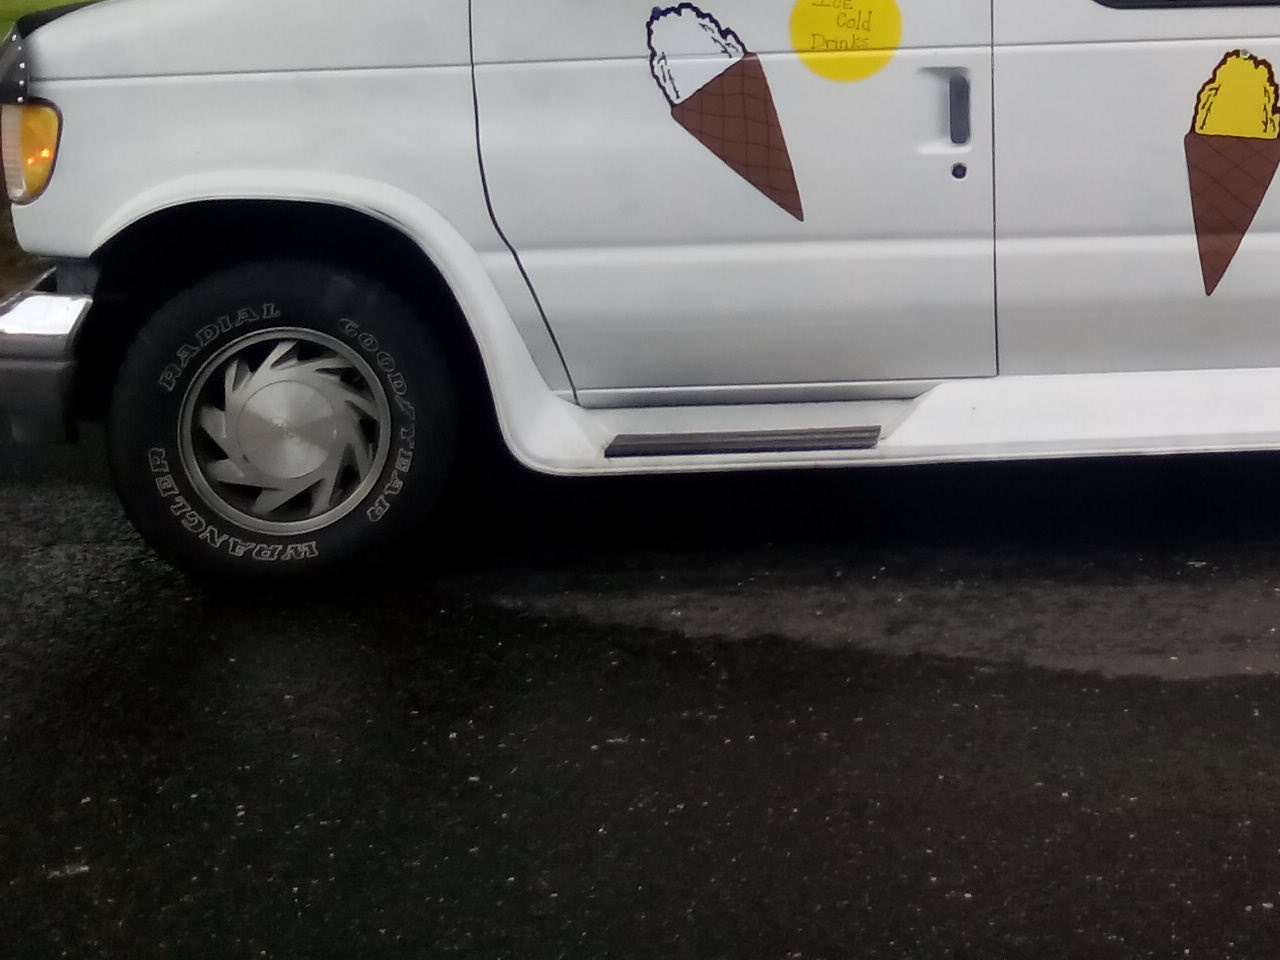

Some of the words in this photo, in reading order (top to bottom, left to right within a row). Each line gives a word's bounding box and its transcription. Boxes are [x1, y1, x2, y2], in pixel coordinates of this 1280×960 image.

[811, 33, 870, 50] Drinks
[836, 10, 872, 33] Cold
[159, 302, 282, 393] RADIAL
[147, 447, 320, 561] WRANGLER
